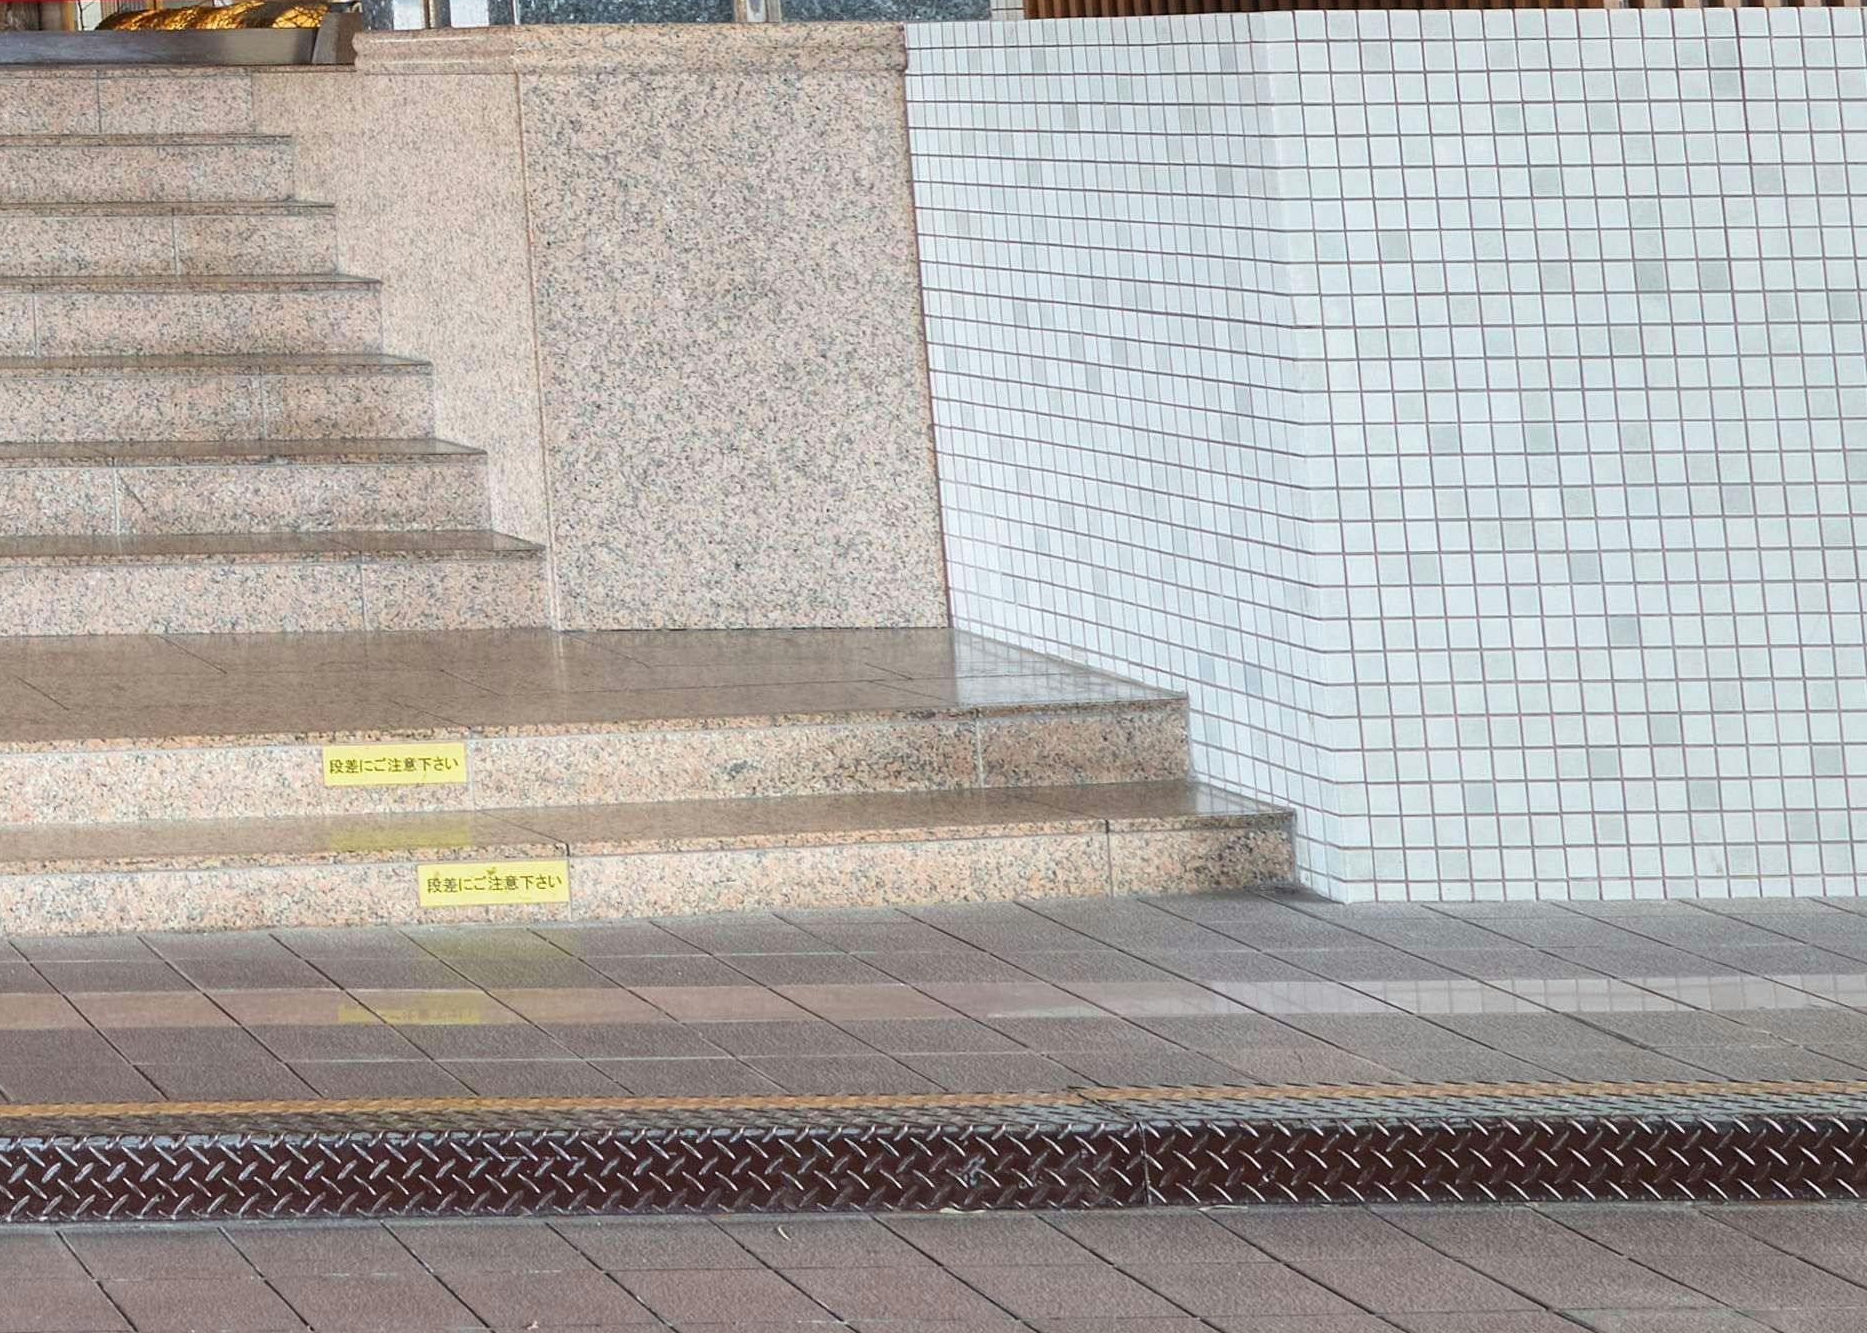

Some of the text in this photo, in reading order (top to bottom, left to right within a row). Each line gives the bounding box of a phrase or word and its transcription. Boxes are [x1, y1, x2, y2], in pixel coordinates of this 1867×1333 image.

[329, 756, 459, 774] 段差にご注意下さい
[427, 874, 562, 894] 段差にご注意下さい
